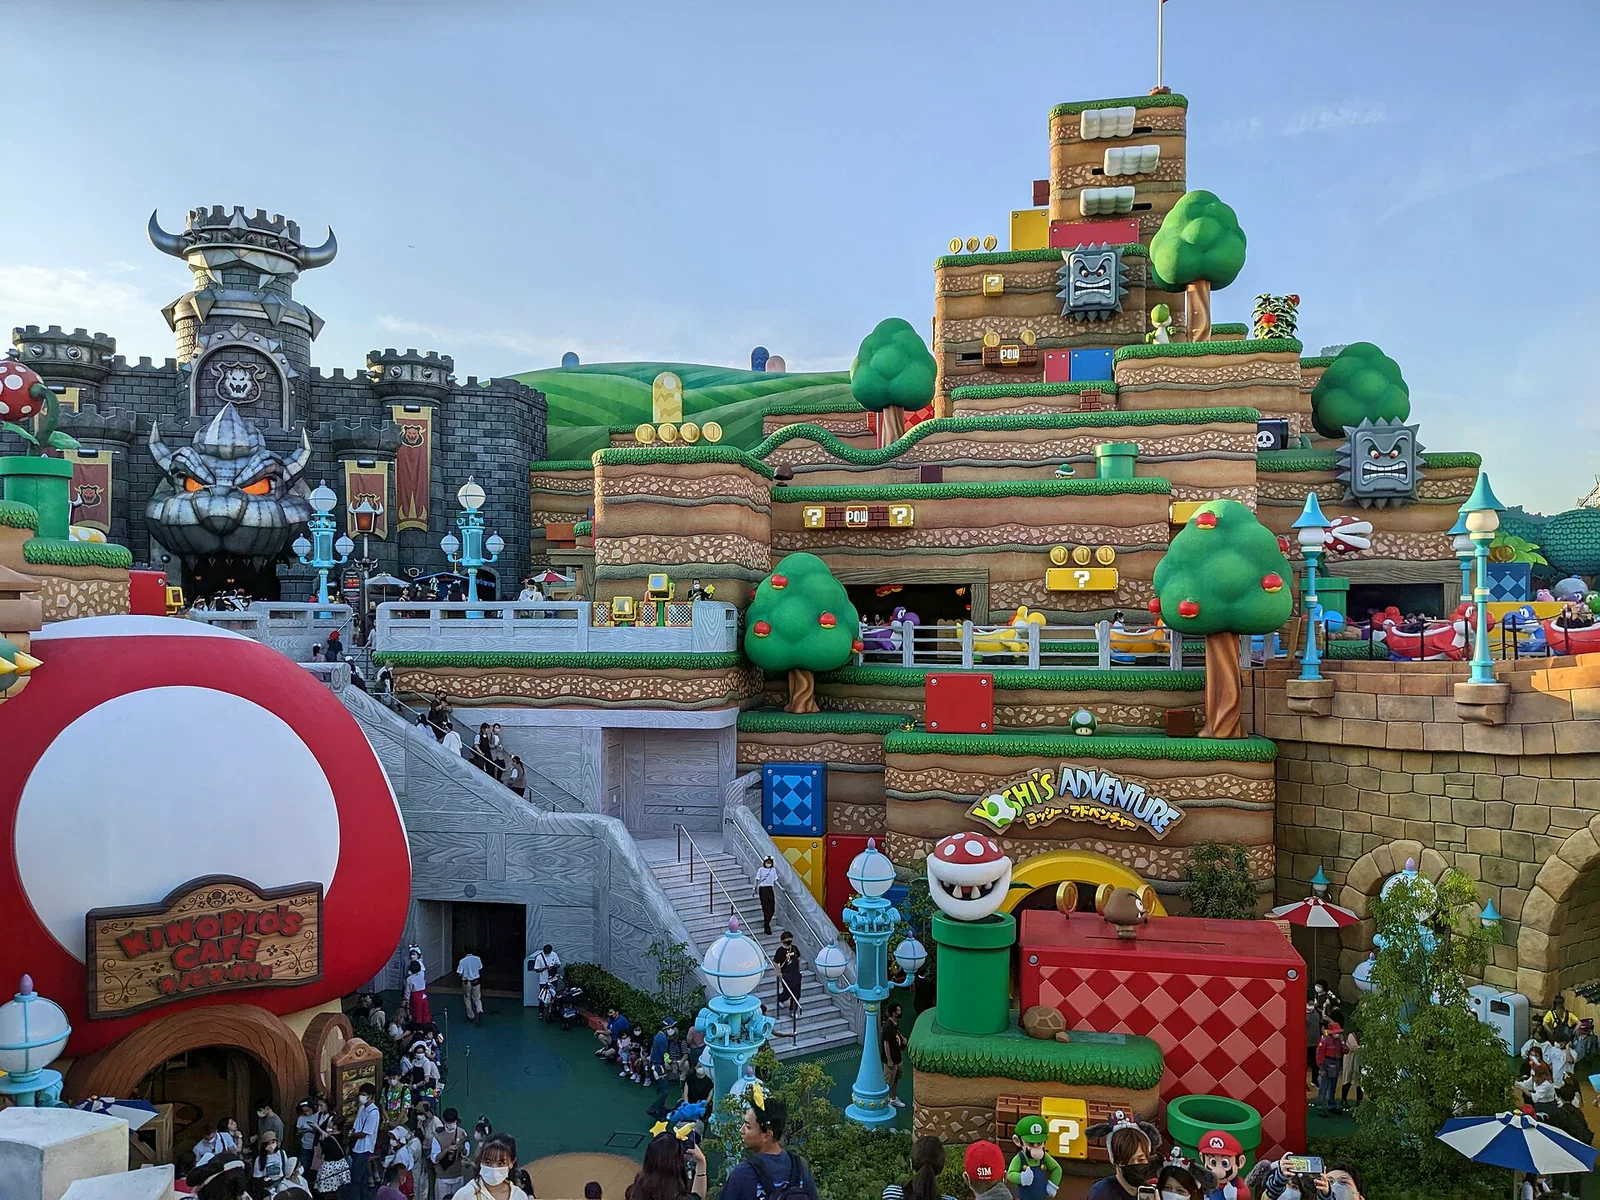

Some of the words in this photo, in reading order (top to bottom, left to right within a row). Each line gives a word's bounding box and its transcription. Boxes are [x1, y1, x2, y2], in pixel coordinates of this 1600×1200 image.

[1000, 348, 1020, 360] POW
[845, 510, 869, 523] POW
[971, 771, 1056, 829] YOSHI'S
[1059, 766, 1181, 835] ADVENTURE
[119, 905, 304, 958] KINOPIO'S
[171, 935, 261, 970] CAFE
